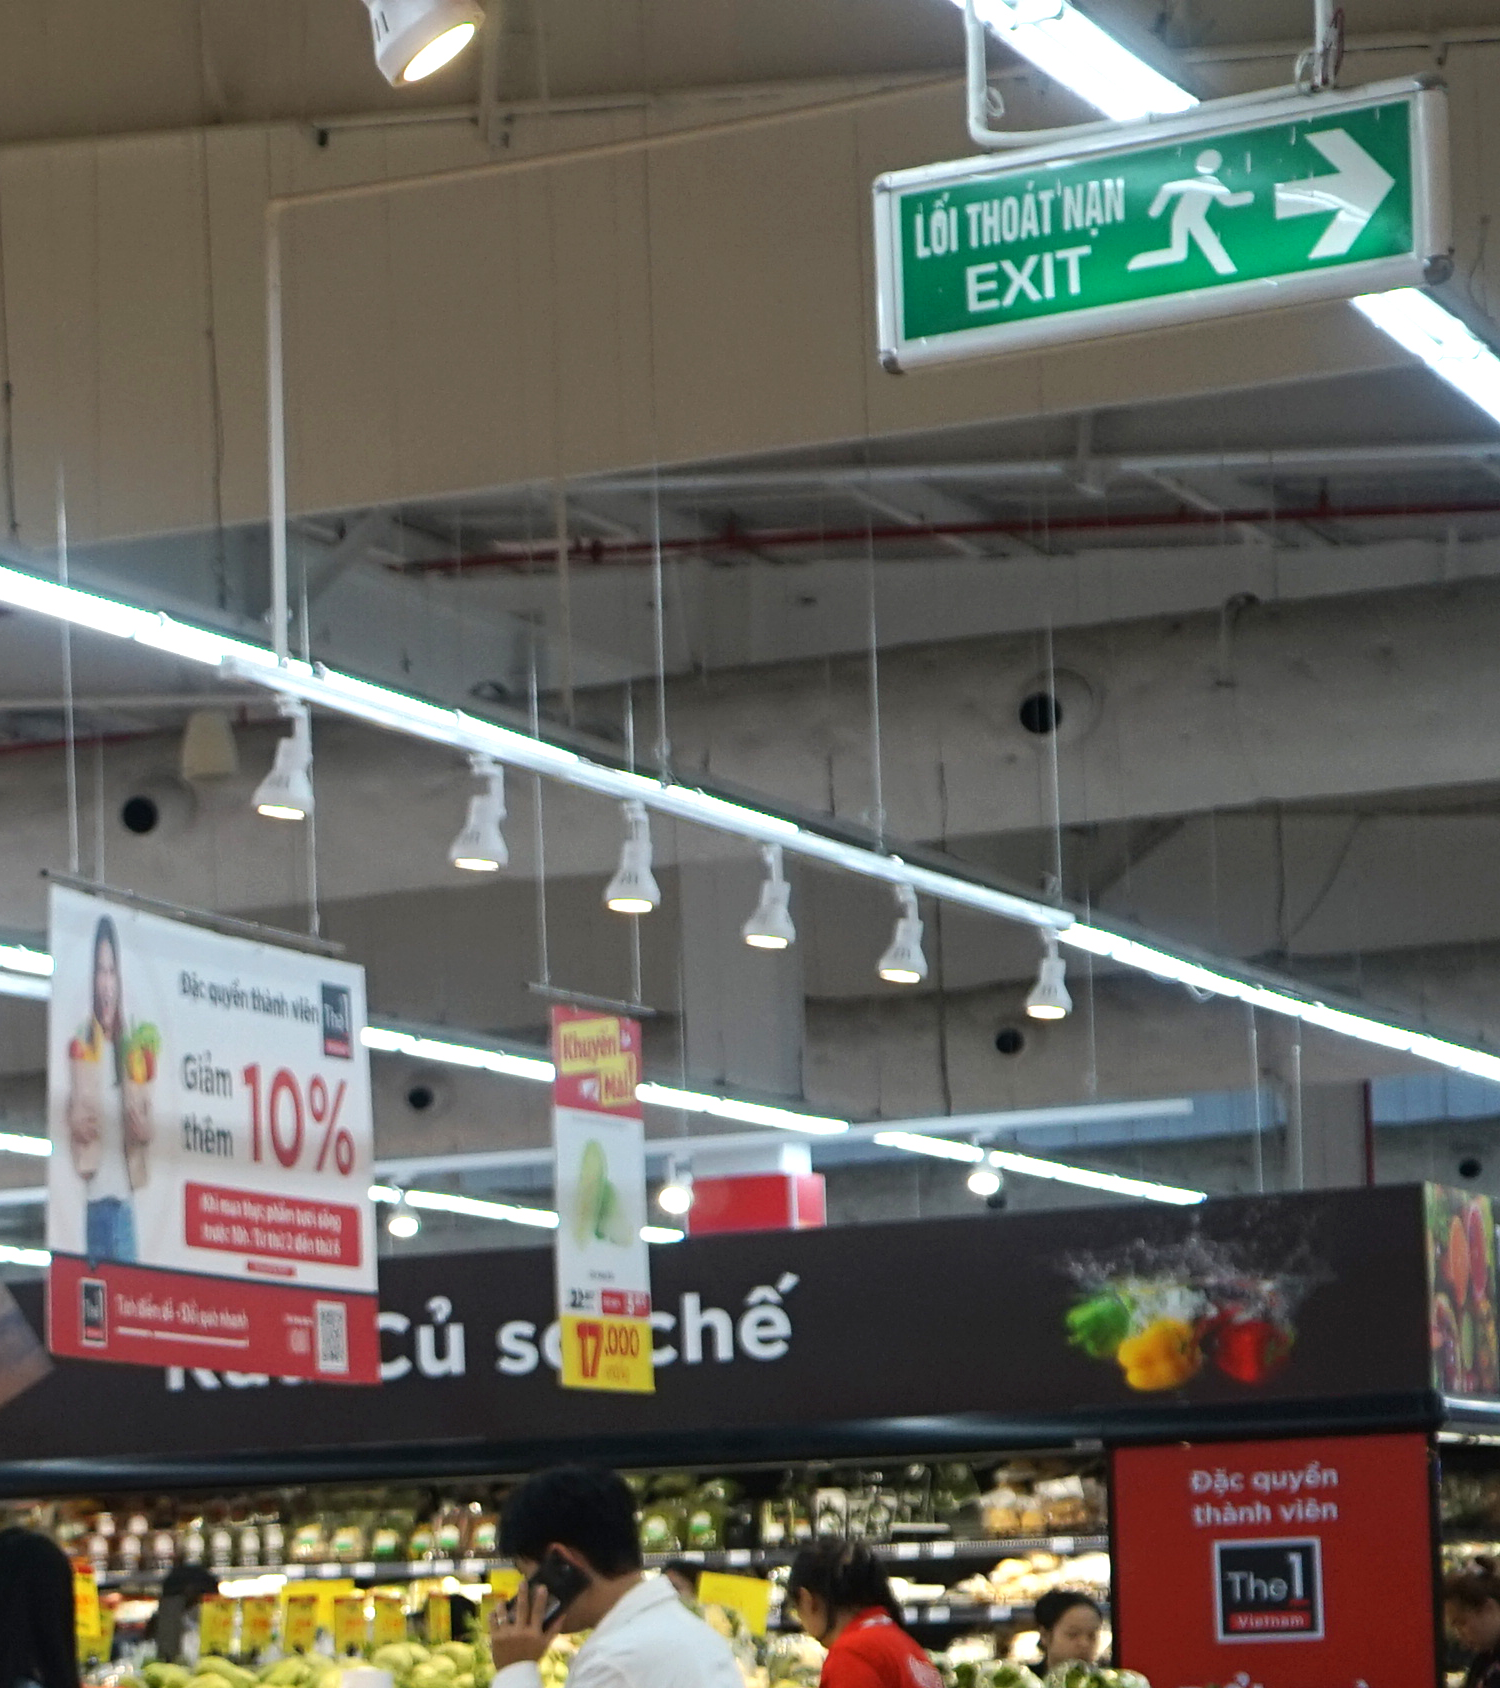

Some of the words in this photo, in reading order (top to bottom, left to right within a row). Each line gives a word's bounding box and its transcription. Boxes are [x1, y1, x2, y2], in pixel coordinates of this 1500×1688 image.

[915, 193, 959, 259] LỐI
[966, 180, 1054, 248] THOÁT
[1061, 178, 1125, 235] NẠN
[966, 245, 1091, 313] EXIT
[183, 1050, 233, 1098] Giảm
[183, 1116, 234, 1159] thêm
[243, 1062, 354, 1175] 10%
[1190, 1469, 1243, 1495] Đặc
[1252, 1461, 1338, 1494] quyền
[1193, 1501, 1271, 1527] thành
[1280, 1498, 1338, 1523] viên
[1236, 1613, 1304, 1628] Vietnam
